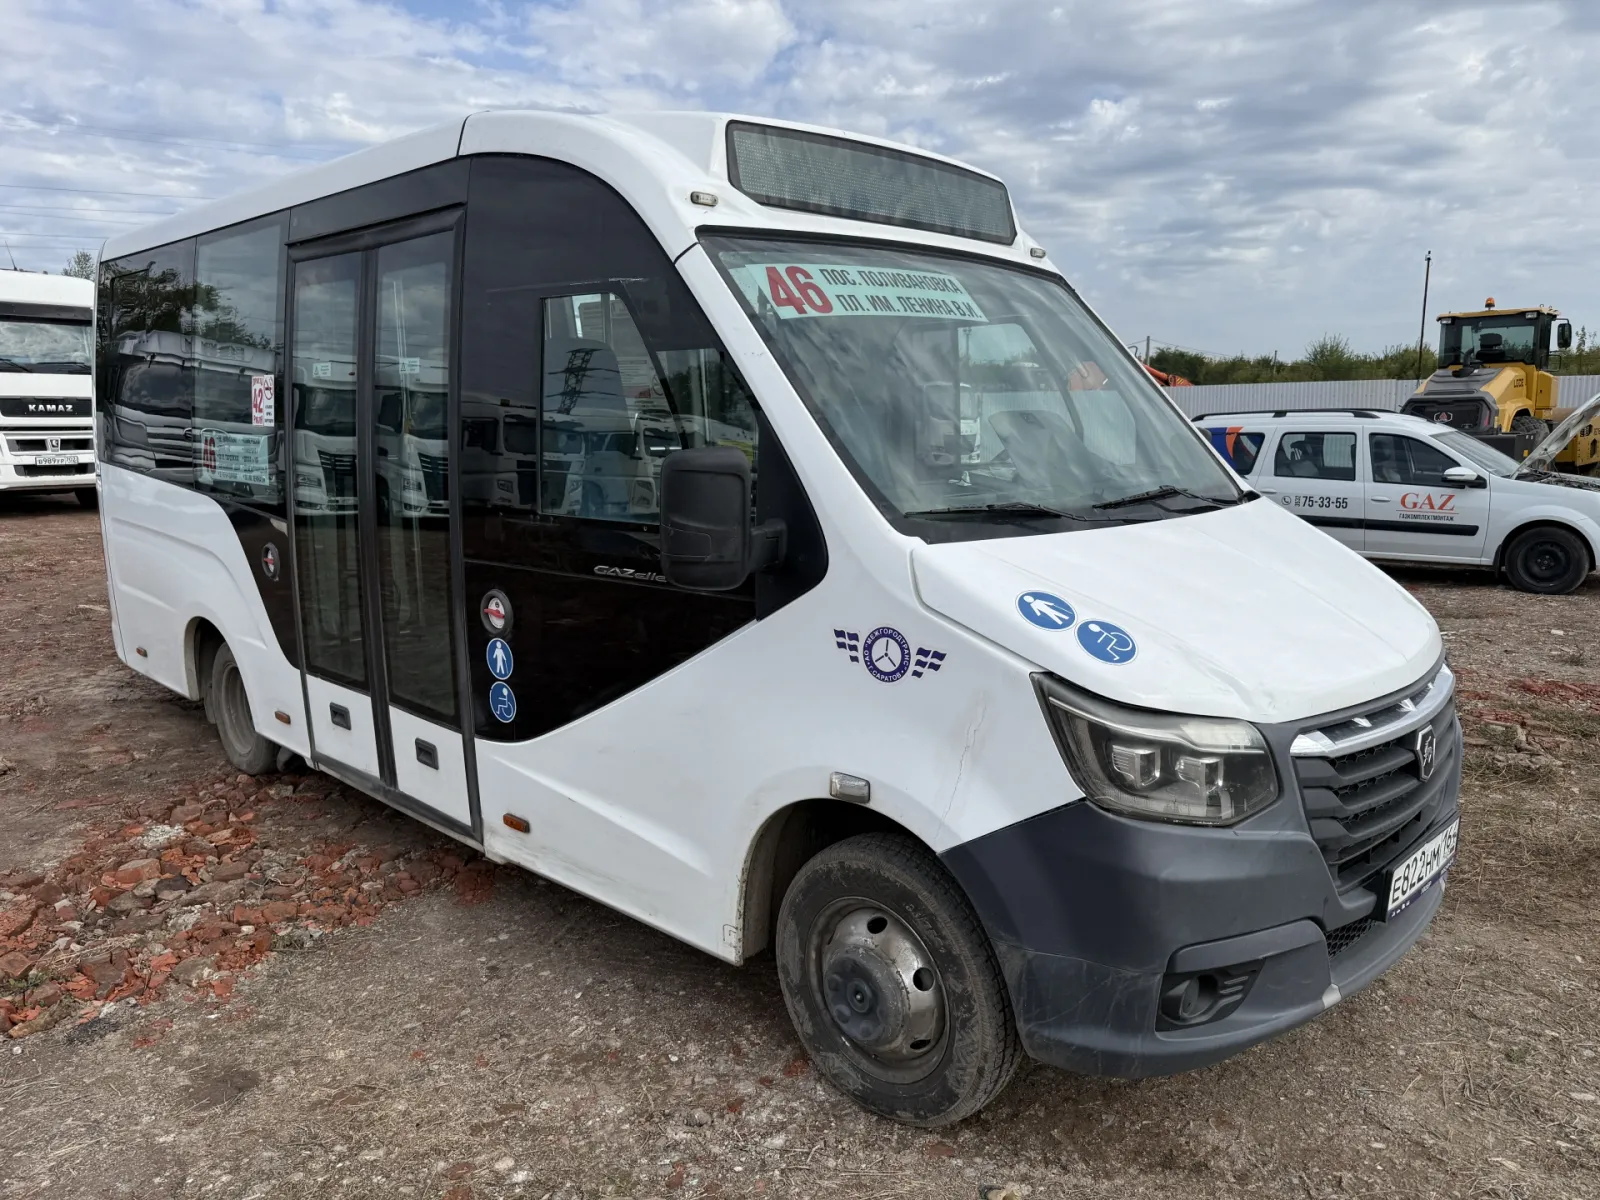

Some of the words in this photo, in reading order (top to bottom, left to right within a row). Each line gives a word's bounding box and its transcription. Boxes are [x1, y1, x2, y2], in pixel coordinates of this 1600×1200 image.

[765, 265, 833, 315] 46
[819, 268, 863, 286] ПОС.
[859, 271, 962, 295] ПОЛИВАНОВКА
[835, 294, 869, 312] ПЛ.
[865, 295, 898, 313] ИМ.
[900, 295, 956, 316] ЛЕНИНА
[953, 301, 983, 319] В.И.
[28, 404, 73, 412] KAMAZ
[253, 388, 263, 413] 42
[1302, 496, 1348, 509] 75-33-55
[1400, 492, 1456, 512] GAZ
[594, 565, 667, 583] GAZelle
[1391, 843, 1440, 904] Е822НМ
